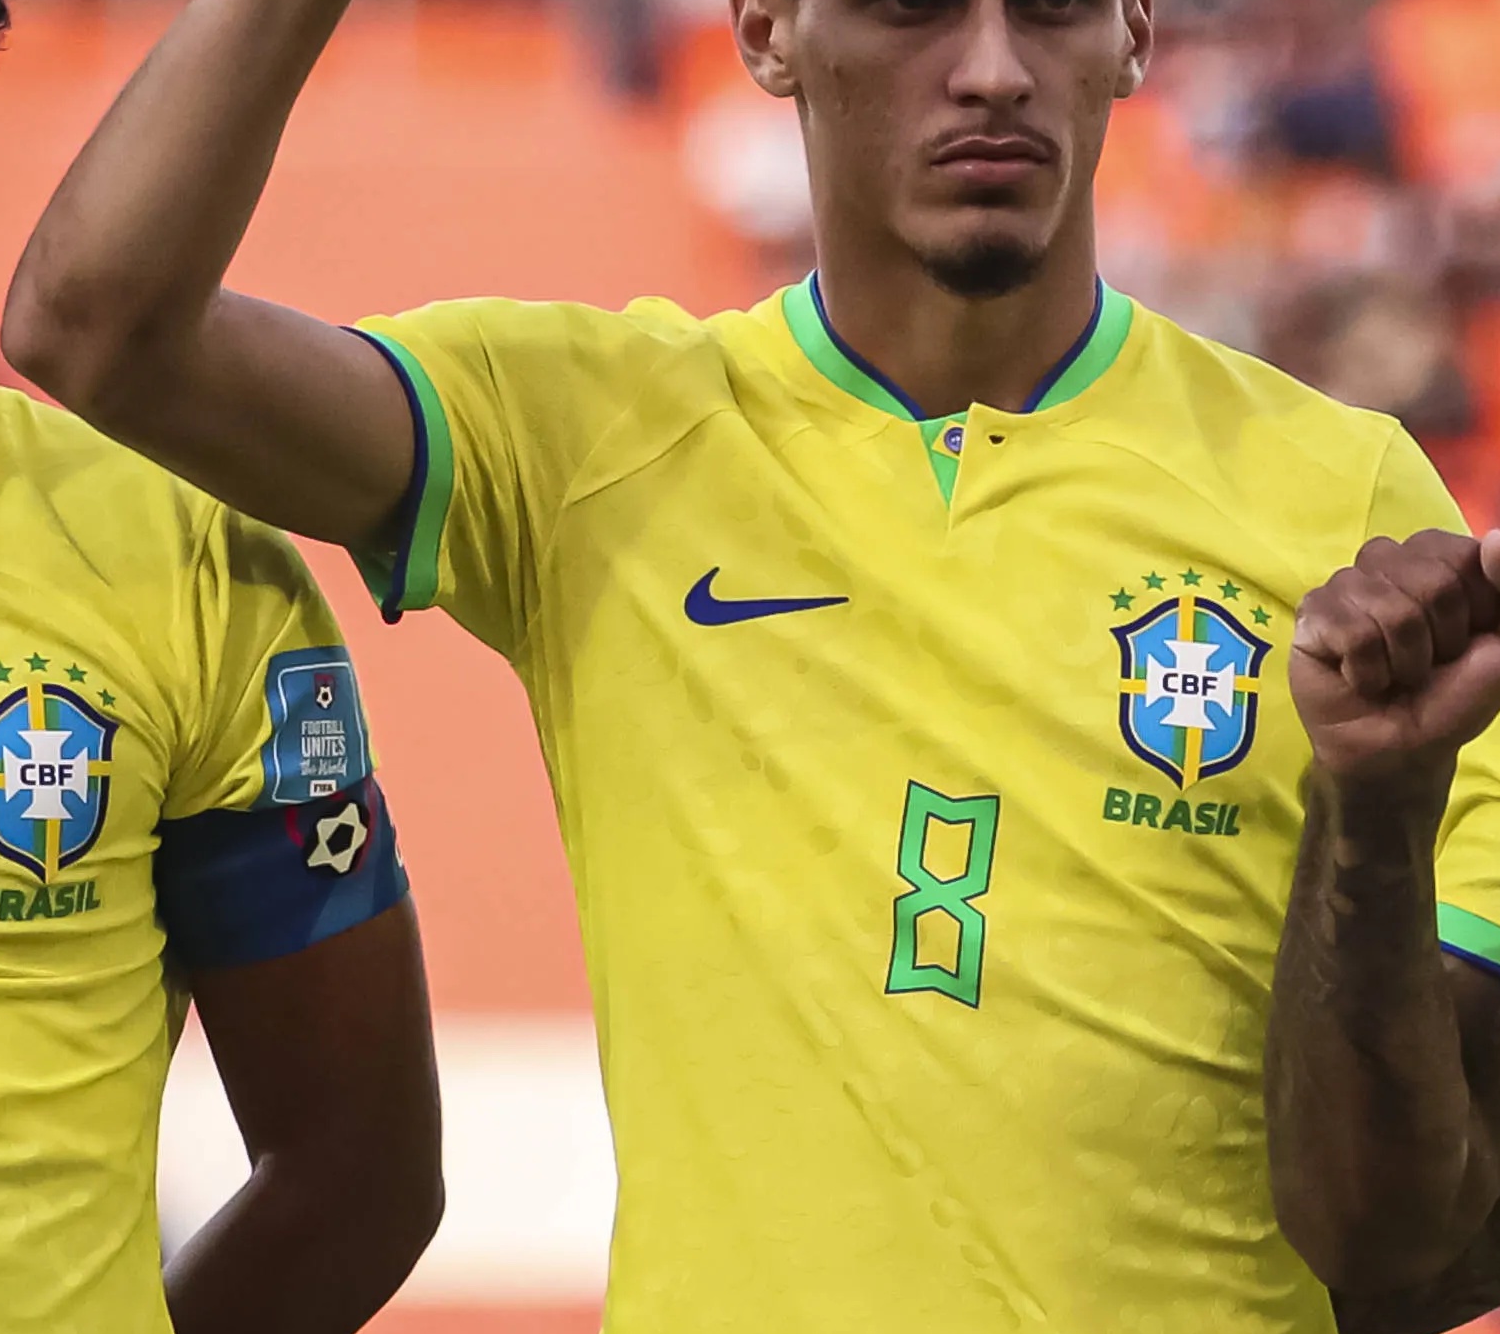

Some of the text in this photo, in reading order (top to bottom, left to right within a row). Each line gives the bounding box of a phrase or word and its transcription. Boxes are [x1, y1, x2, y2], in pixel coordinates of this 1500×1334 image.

[1161, 671, 1219, 697] CBF
[302, 720, 345, 734] FOOTBALL
[301, 735, 346, 757] UNITES
[19, 762, 74, 787] CBF
[1103, 786, 1241, 837] BRASIL
[885, 779, 1000, 1010] 8
